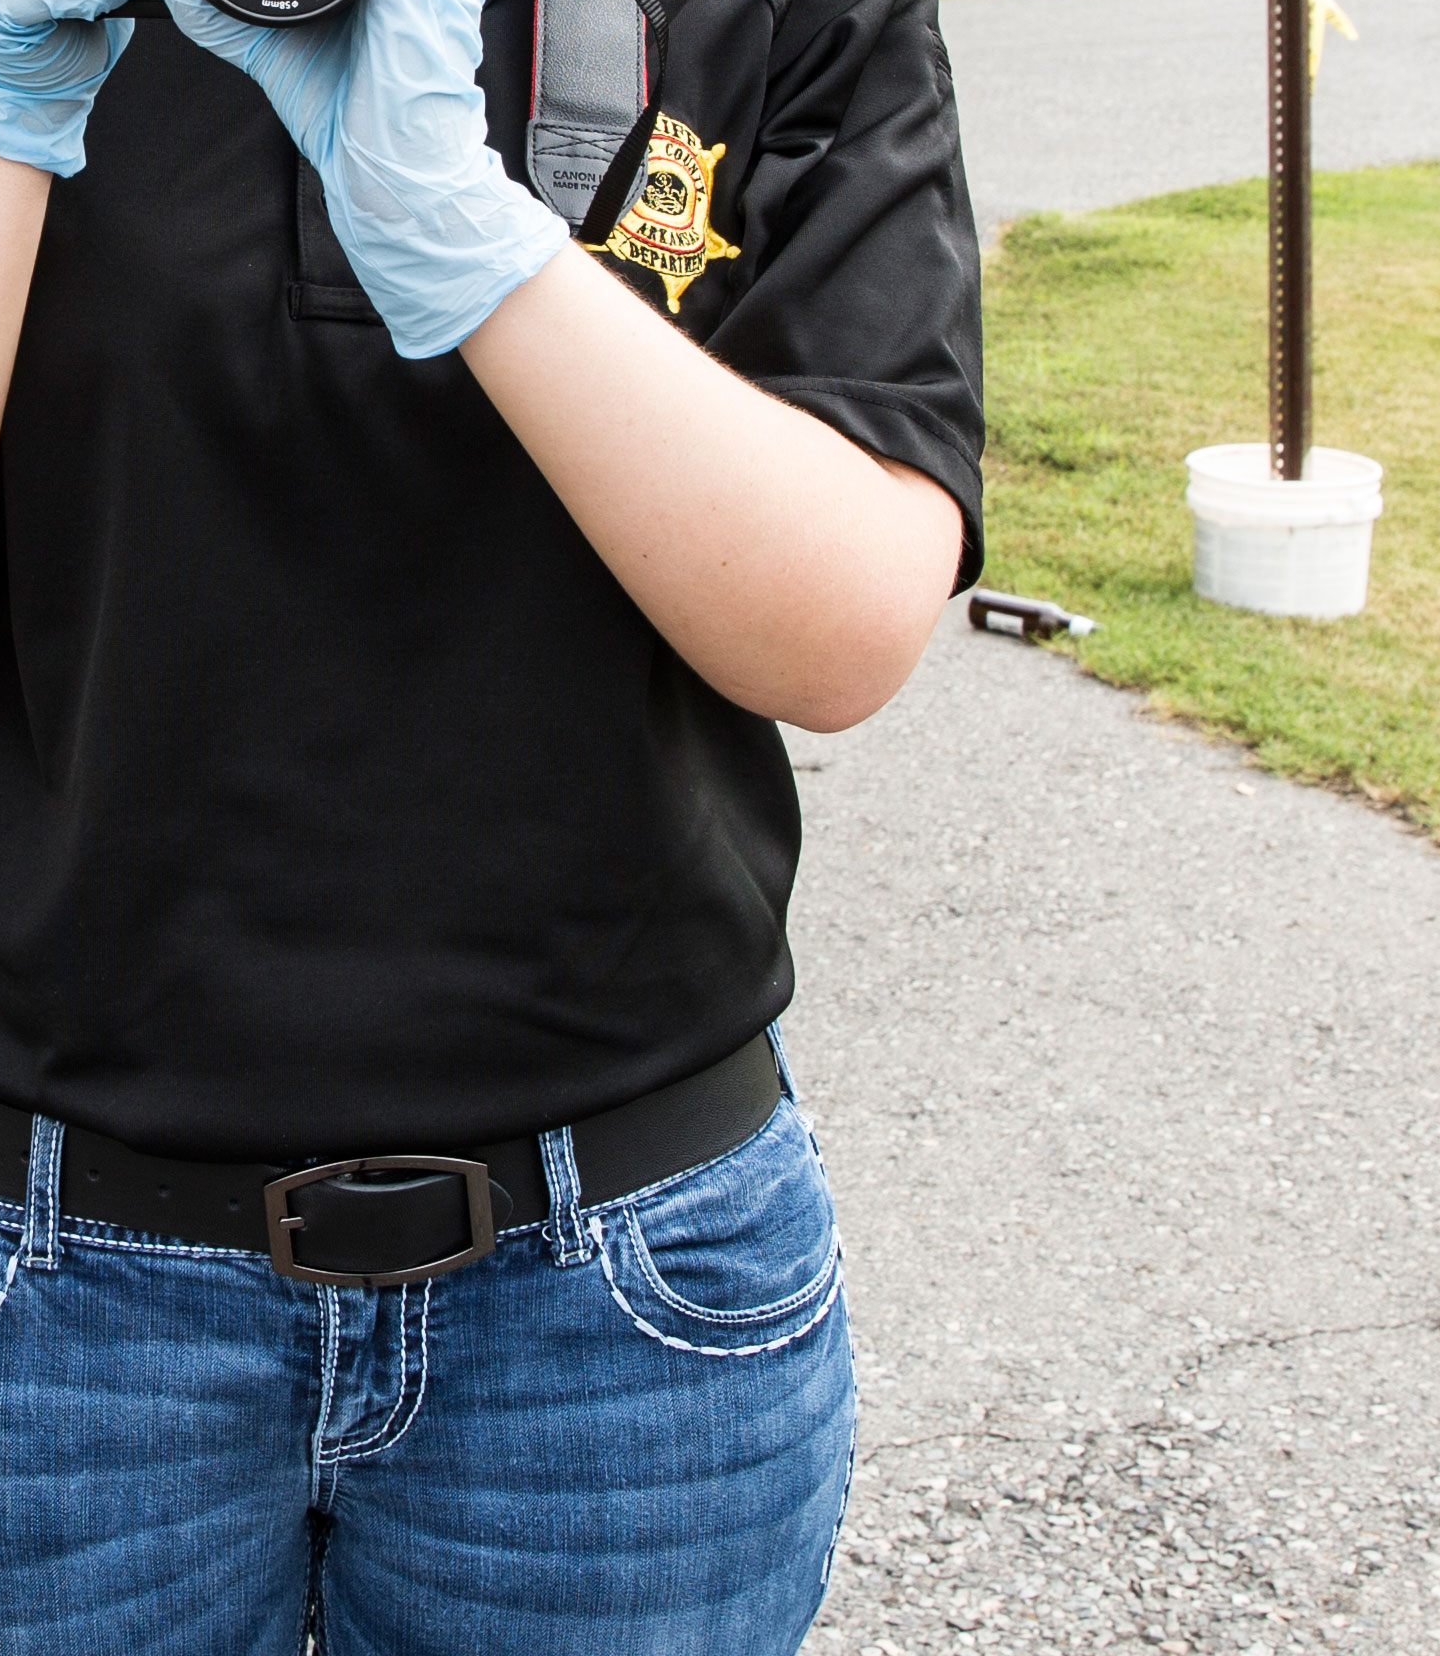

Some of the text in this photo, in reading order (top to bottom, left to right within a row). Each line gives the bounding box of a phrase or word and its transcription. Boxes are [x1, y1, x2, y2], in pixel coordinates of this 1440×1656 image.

[552, 170, 596, 183] CANON
[665, 142, 707, 195] COUNTY
[552, 181, 579, 190] MADE
[580, 183, 590, 191] IN
[636, 222, 700, 247] ARKANSAS
